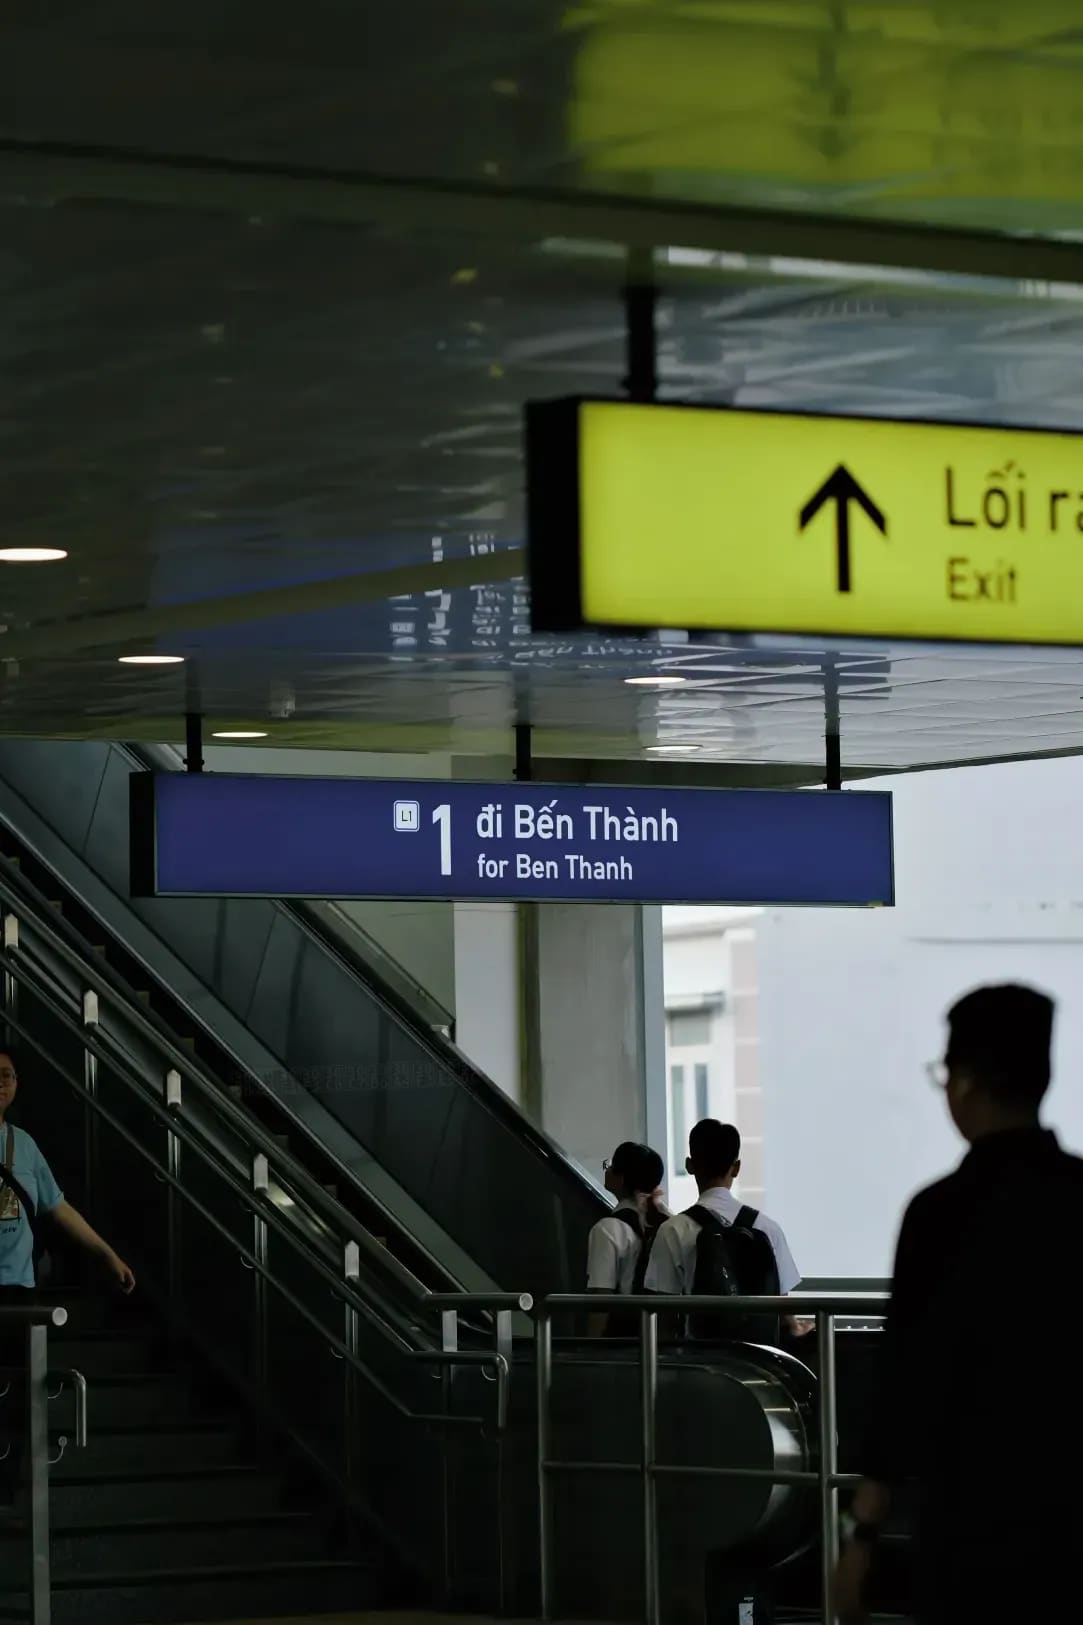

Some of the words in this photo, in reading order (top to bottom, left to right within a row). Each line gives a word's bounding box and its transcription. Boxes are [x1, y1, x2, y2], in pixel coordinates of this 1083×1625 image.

[945, 460, 1025, 531] Lối
[947, 556, 1017, 602] Exit
[401, 810, 412, 822] L1
[476, 803, 502, 838] đi
[514, 800, 573, 840] Bến
[583, 805, 679, 842] Thành
[432, 804, 452, 876] 1
[477, 853, 509, 878] for
[516, 854, 559, 879] Ben
[564, 854, 633, 881] Thanh
